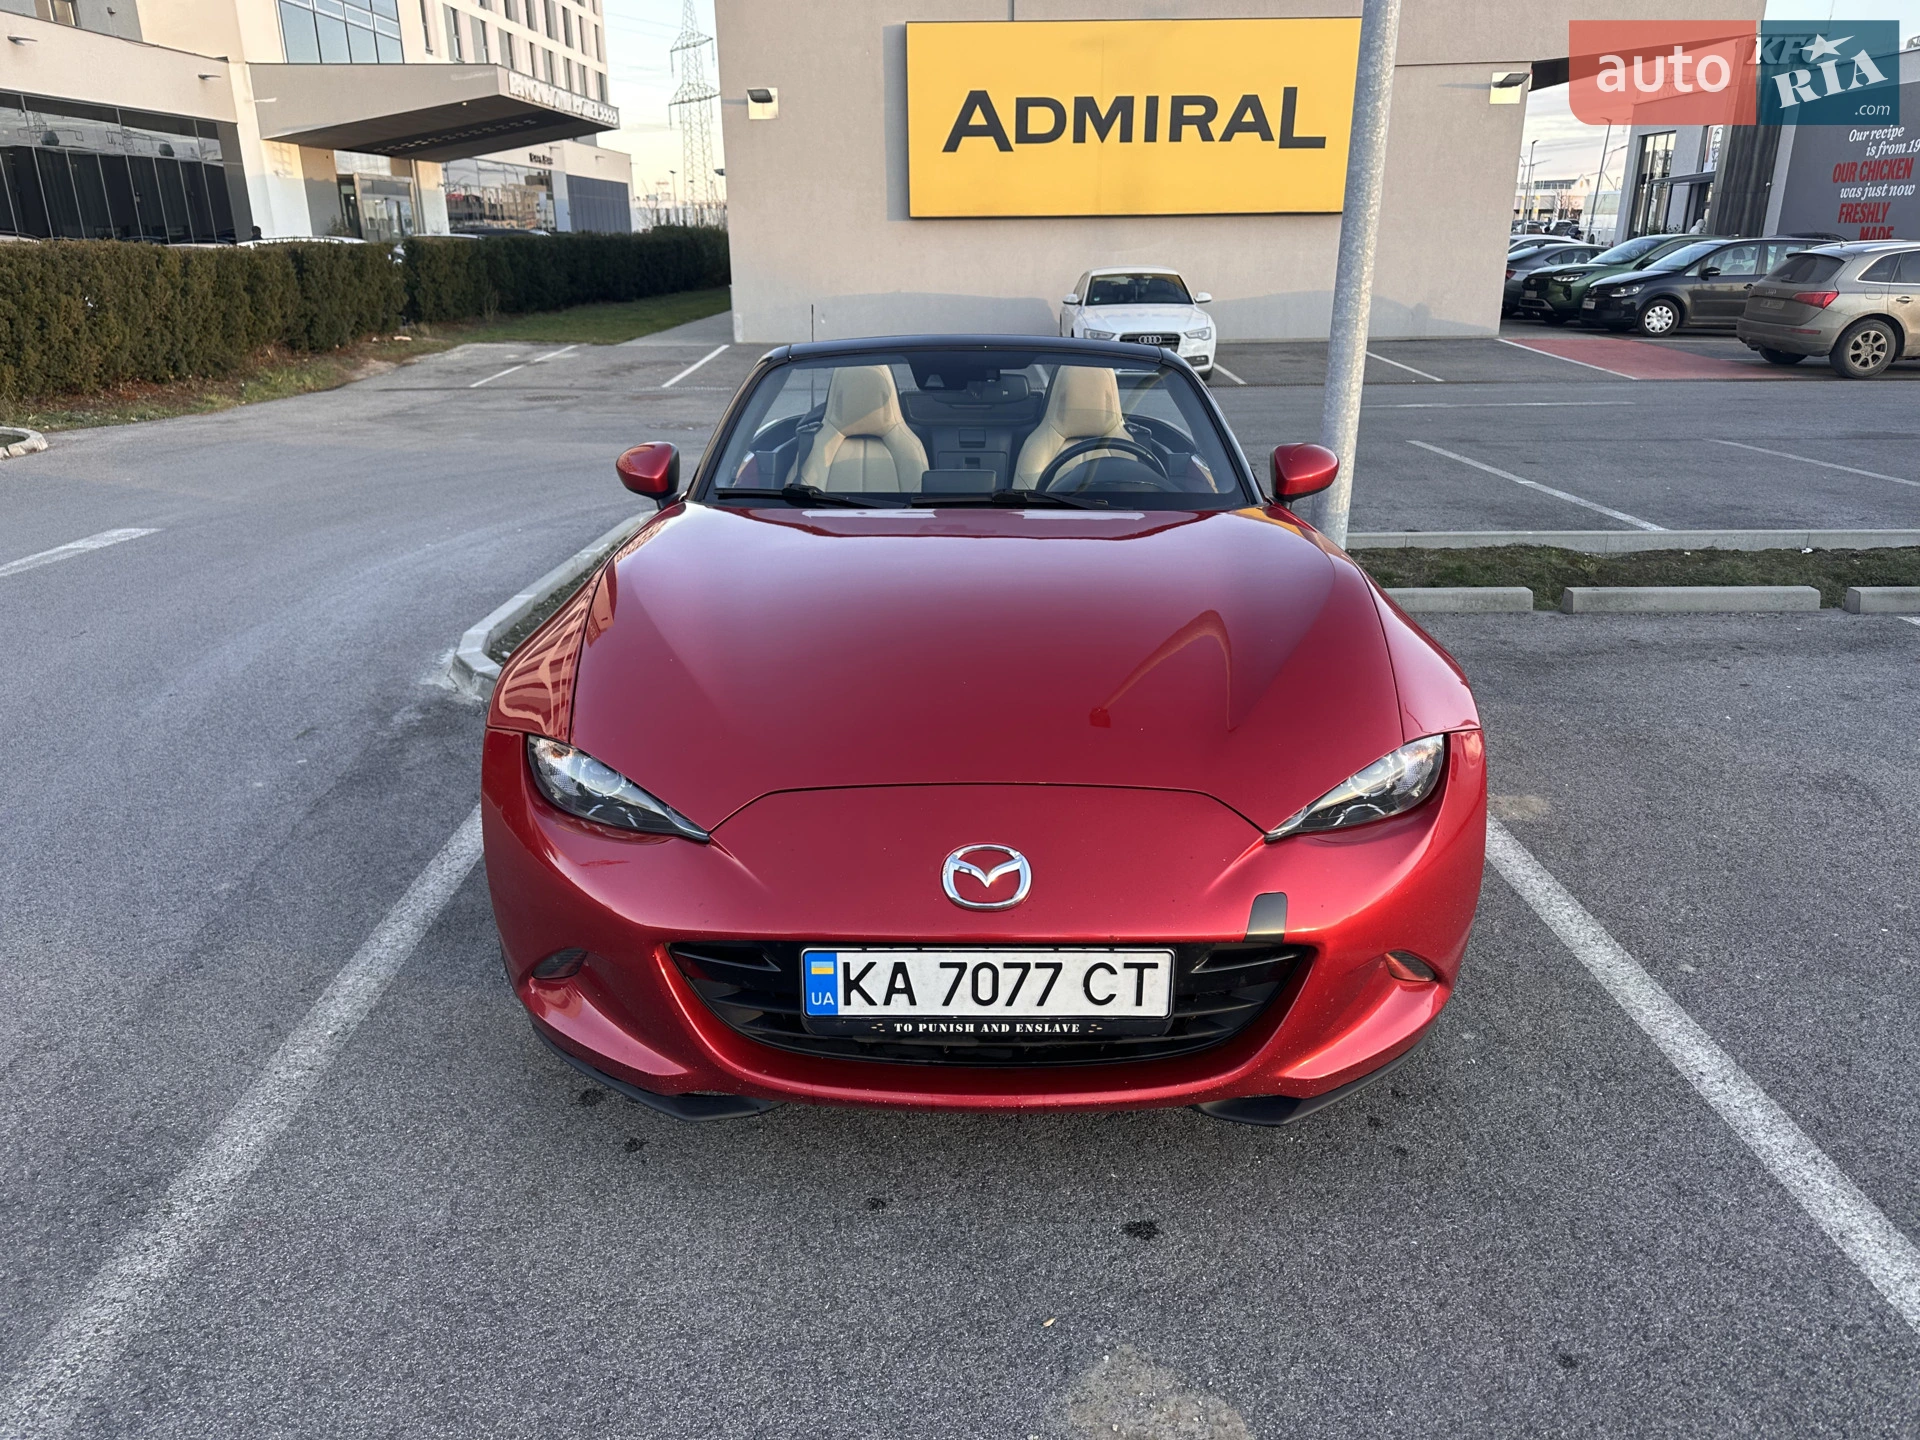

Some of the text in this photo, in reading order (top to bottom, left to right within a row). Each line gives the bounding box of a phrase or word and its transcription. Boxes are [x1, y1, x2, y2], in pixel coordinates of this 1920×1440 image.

[941, 86, 1327, 153] ADMIRAL
[1848, 124, 1905, 143] Our recipe
[1866, 142, 1877, 157] is
[1874, 140, 1907, 159] from
[1832, 157, 1915, 183] OUR CHICKEN
[1840, 182, 1916, 201] was just now
[1837, 201, 1892, 224] FRESHLY
[1858, 226, 1895, 240] MADE
[842, 961, 1159, 1007] KA 7077 CT
[811, 992, 835, 1006] UA
[894, 1023, 1080, 1033] TO PUNISH AND ENSLAVE
